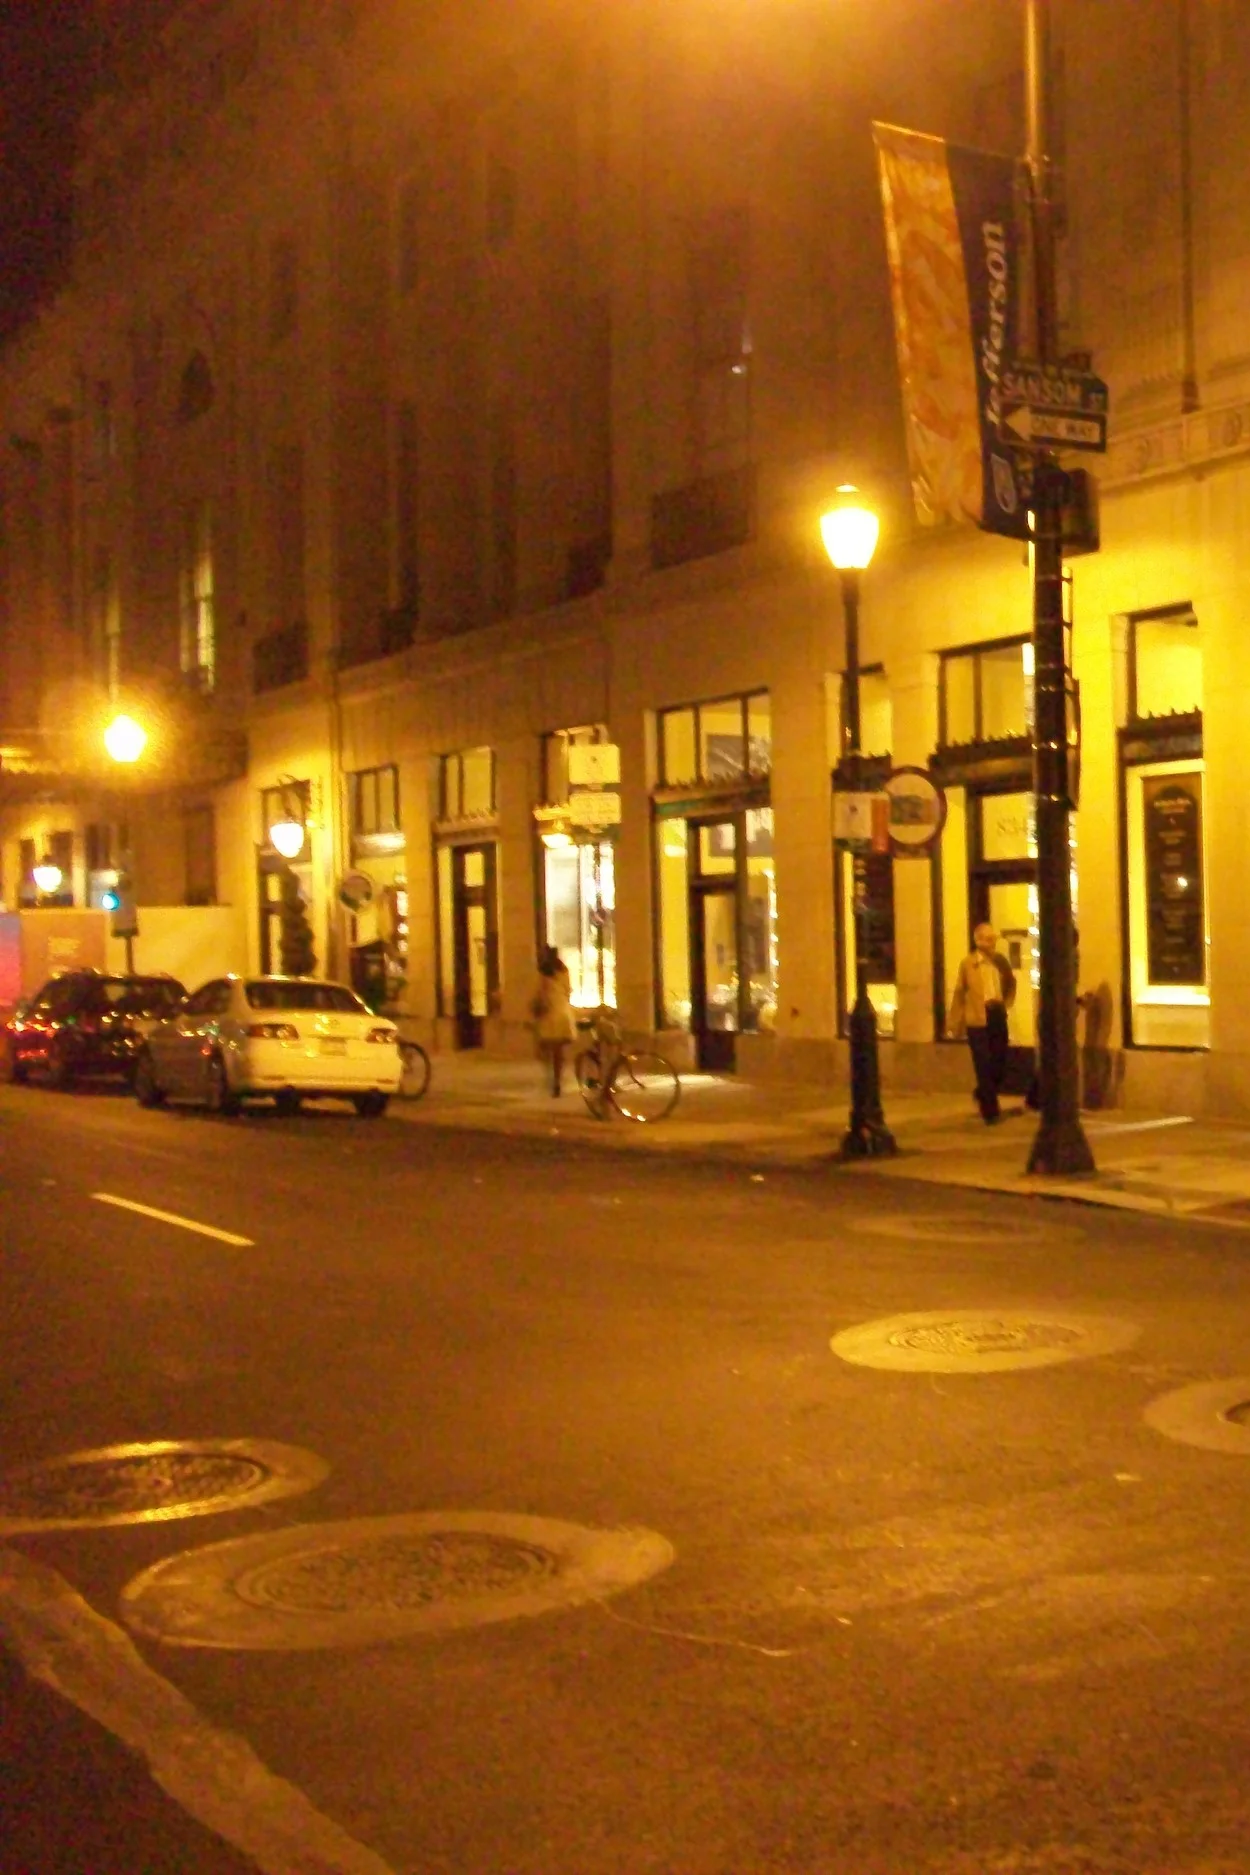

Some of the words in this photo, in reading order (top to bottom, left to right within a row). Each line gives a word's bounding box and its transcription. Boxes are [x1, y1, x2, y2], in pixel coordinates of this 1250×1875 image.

[1001, 371, 1082, 405] SANSOM
[1031, 415, 1059, 435] ONE
[1064, 418, 1098, 440] WAY
